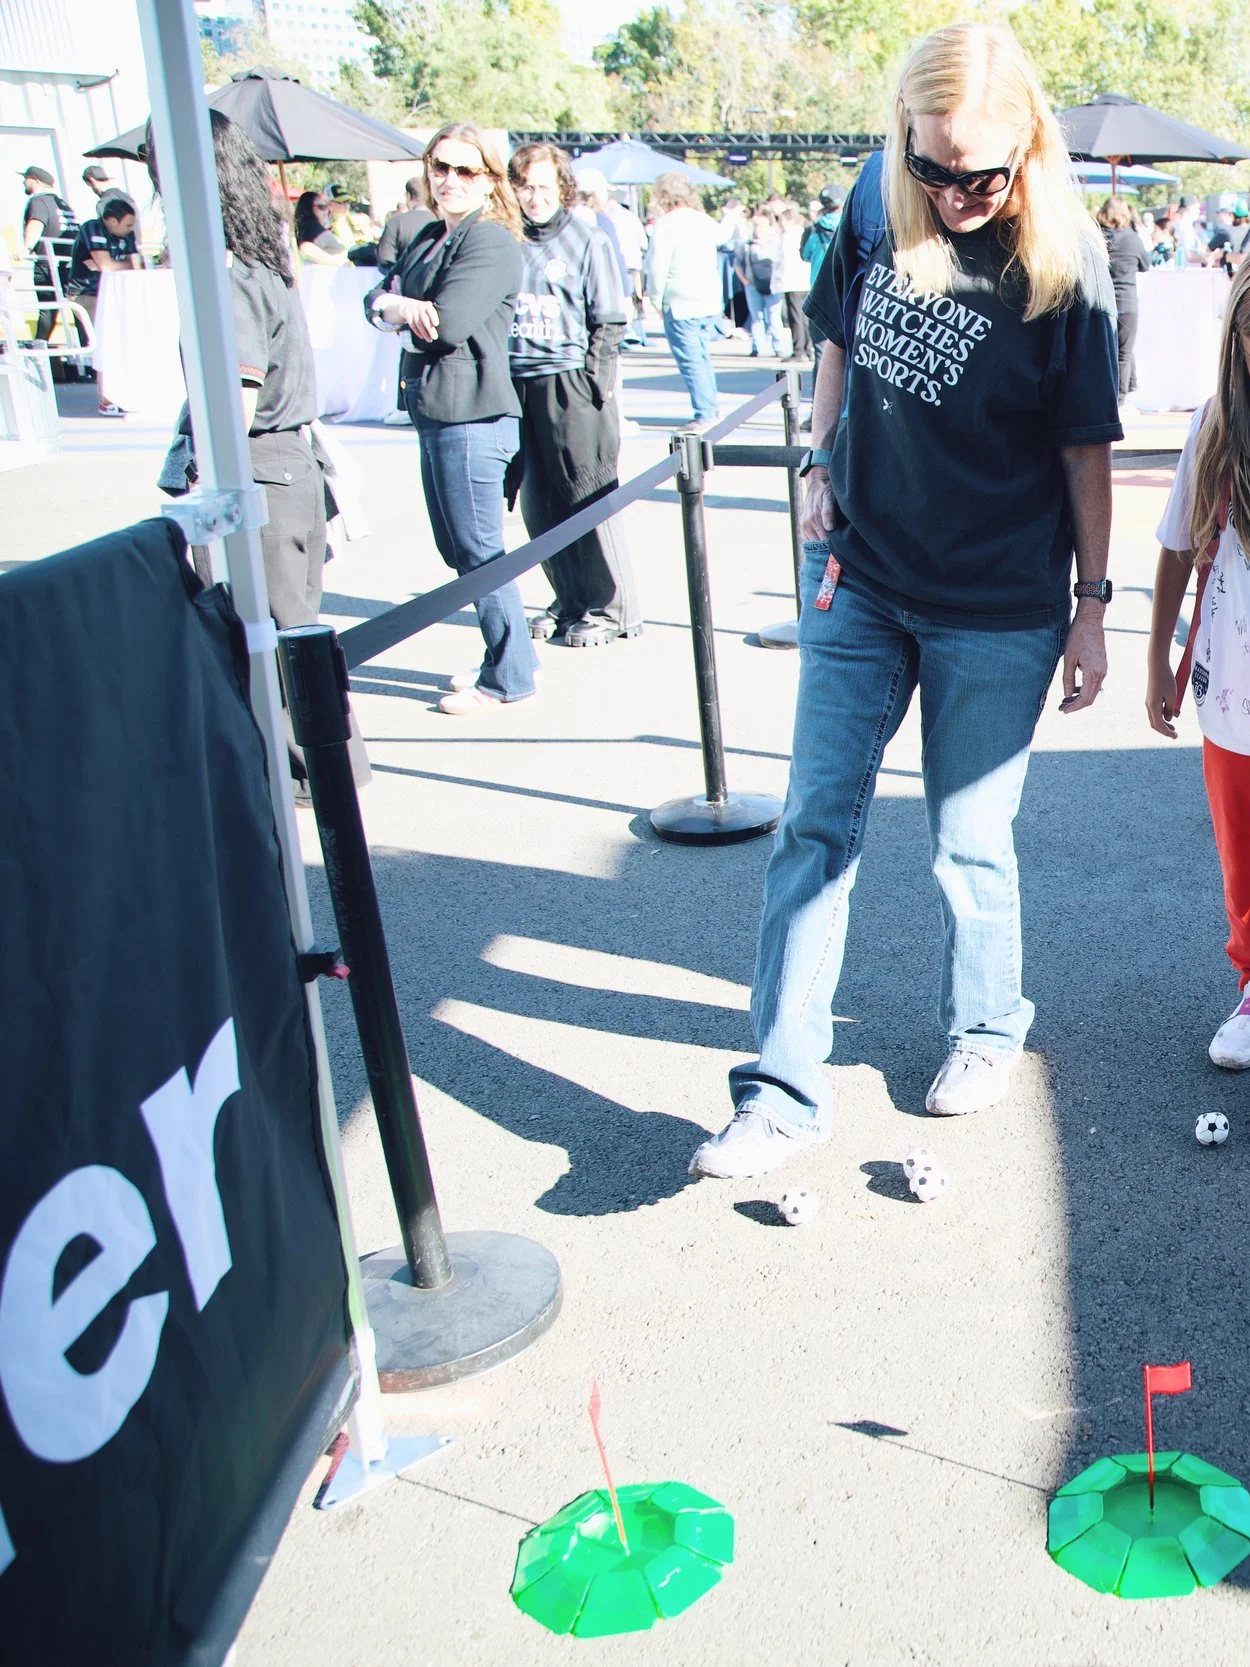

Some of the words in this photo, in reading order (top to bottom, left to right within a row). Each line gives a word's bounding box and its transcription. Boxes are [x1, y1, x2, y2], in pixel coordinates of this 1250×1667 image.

[515, 292, 561, 319] CVS
[861, 288, 975, 362] WATCHES
[866, 263, 993, 342] EVERYONE
[854, 343, 942, 406] SPORTS.
[855, 313, 964, 386] WOMEN'S
[0, 1016, 242, 1575] er
